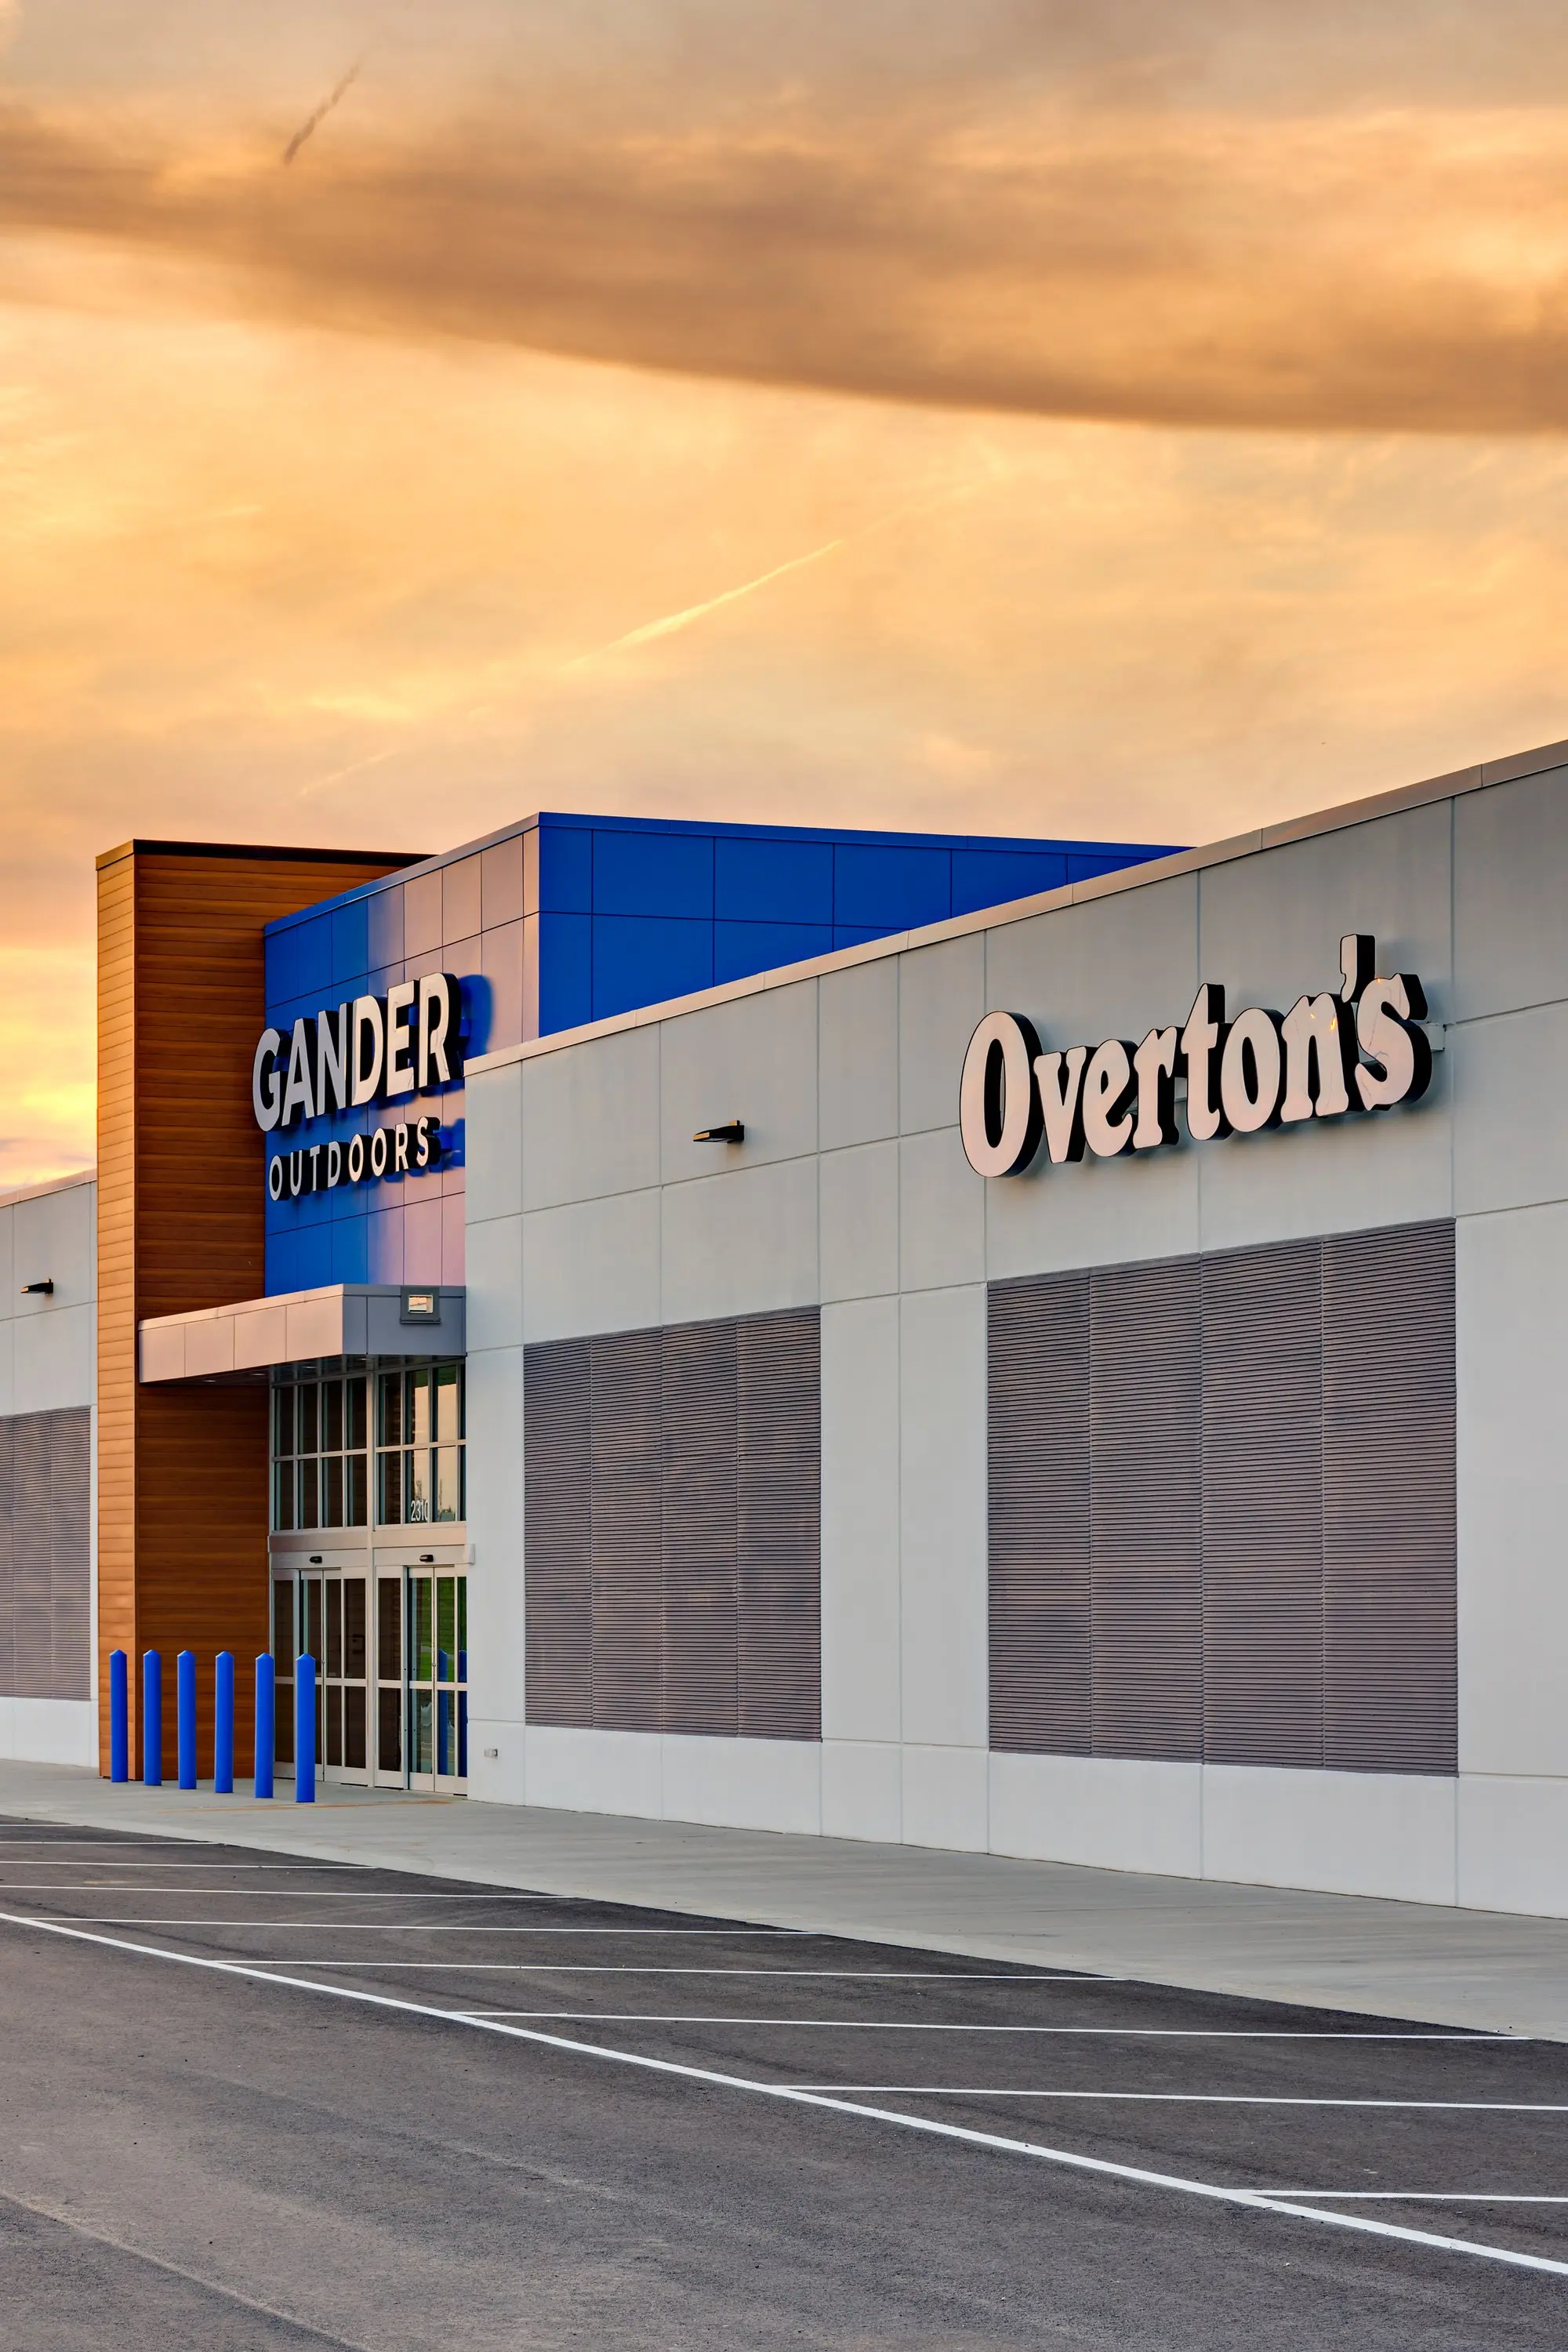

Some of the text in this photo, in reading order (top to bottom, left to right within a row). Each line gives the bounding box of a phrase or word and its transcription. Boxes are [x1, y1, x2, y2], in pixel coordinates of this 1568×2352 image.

[252, 972, 461, 1131] GANDER
[960, 934, 1432, 1178] Overton's
[269, 1116, 439, 1201] OUTDOORS
